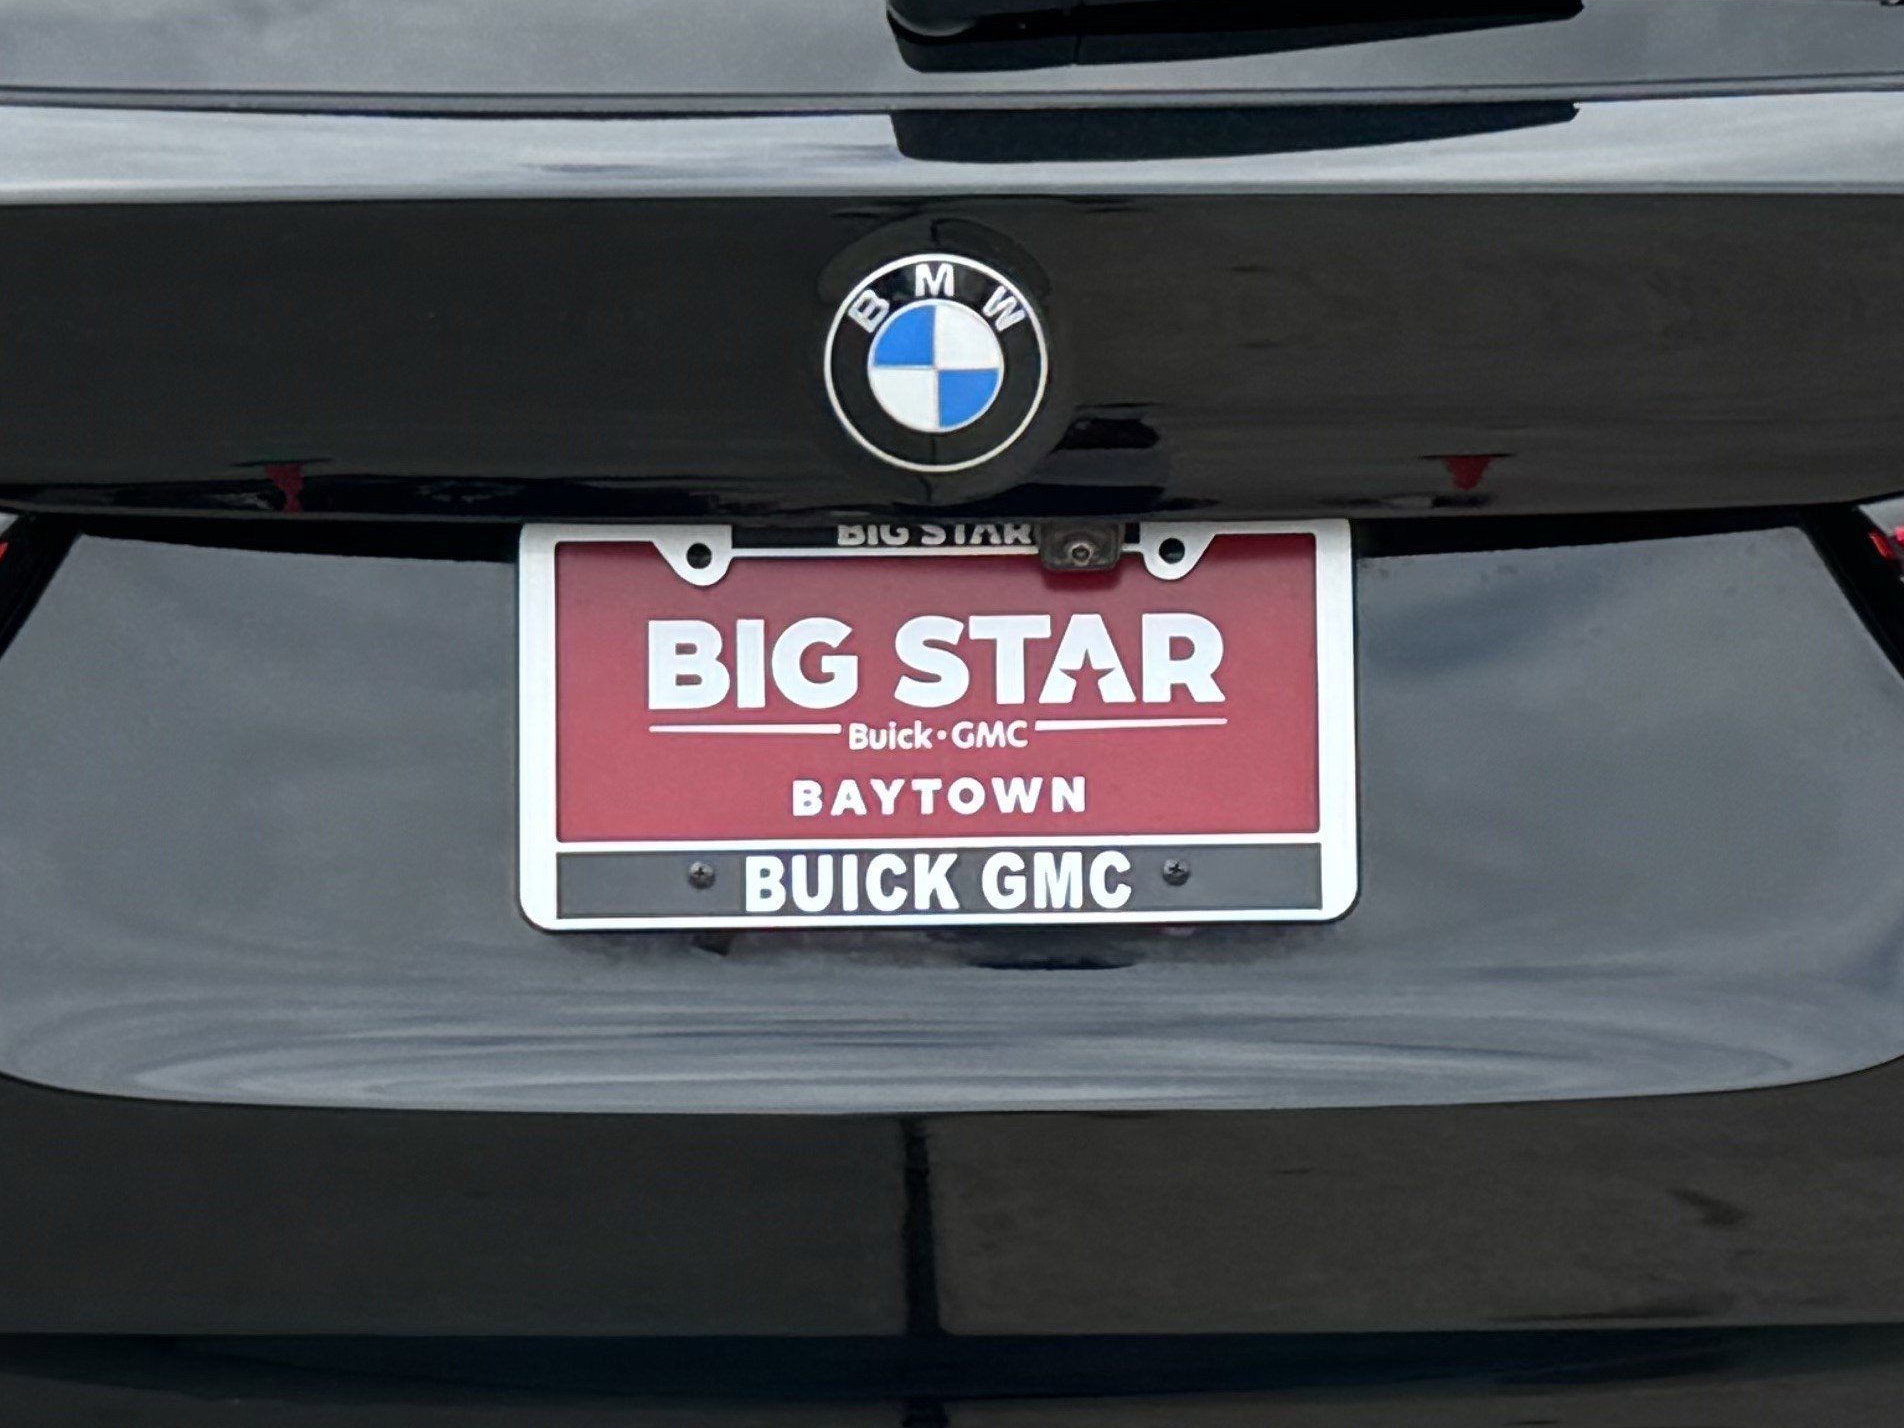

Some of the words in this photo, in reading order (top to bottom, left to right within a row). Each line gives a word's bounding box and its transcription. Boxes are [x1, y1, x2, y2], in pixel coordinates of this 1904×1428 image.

[848, 262, 1026, 334] BMW
[837, 523, 910, 546] BIG
[921, 522, 1032, 546] STAR
[648, 617, 859, 710] BIG
[894, 613, 1226, 708] STAR
[792, 776, 1086, 816] BAYTOWN
[745, 853, 960, 913] BUICK
[982, 850, 1132, 910] GMC
